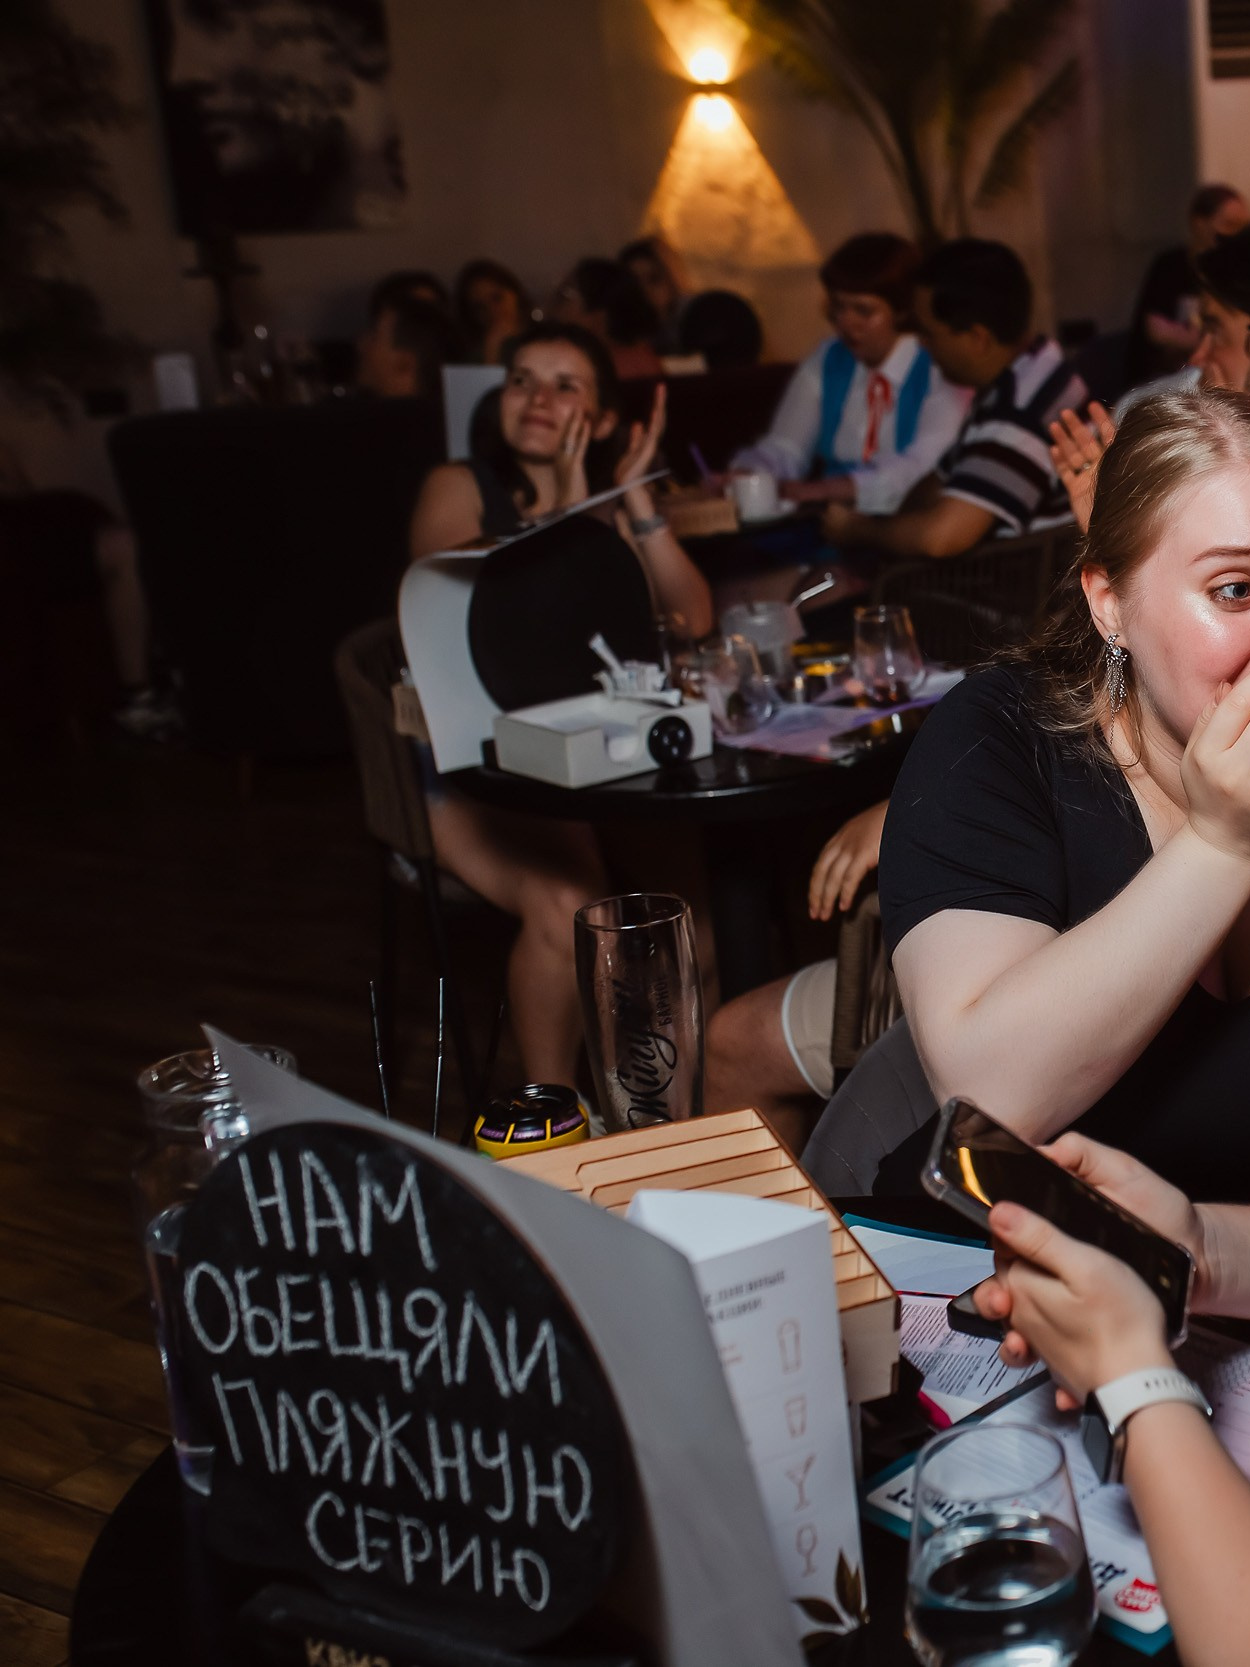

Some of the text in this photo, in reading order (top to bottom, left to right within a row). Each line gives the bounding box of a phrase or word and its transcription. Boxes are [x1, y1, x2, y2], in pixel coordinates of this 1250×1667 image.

[239, 1149, 438, 1272] НАМ
[211, 1373, 594, 1532] ПЛЯЖНУЮ
[305, 1490, 551, 1613] СЕРИЮ
